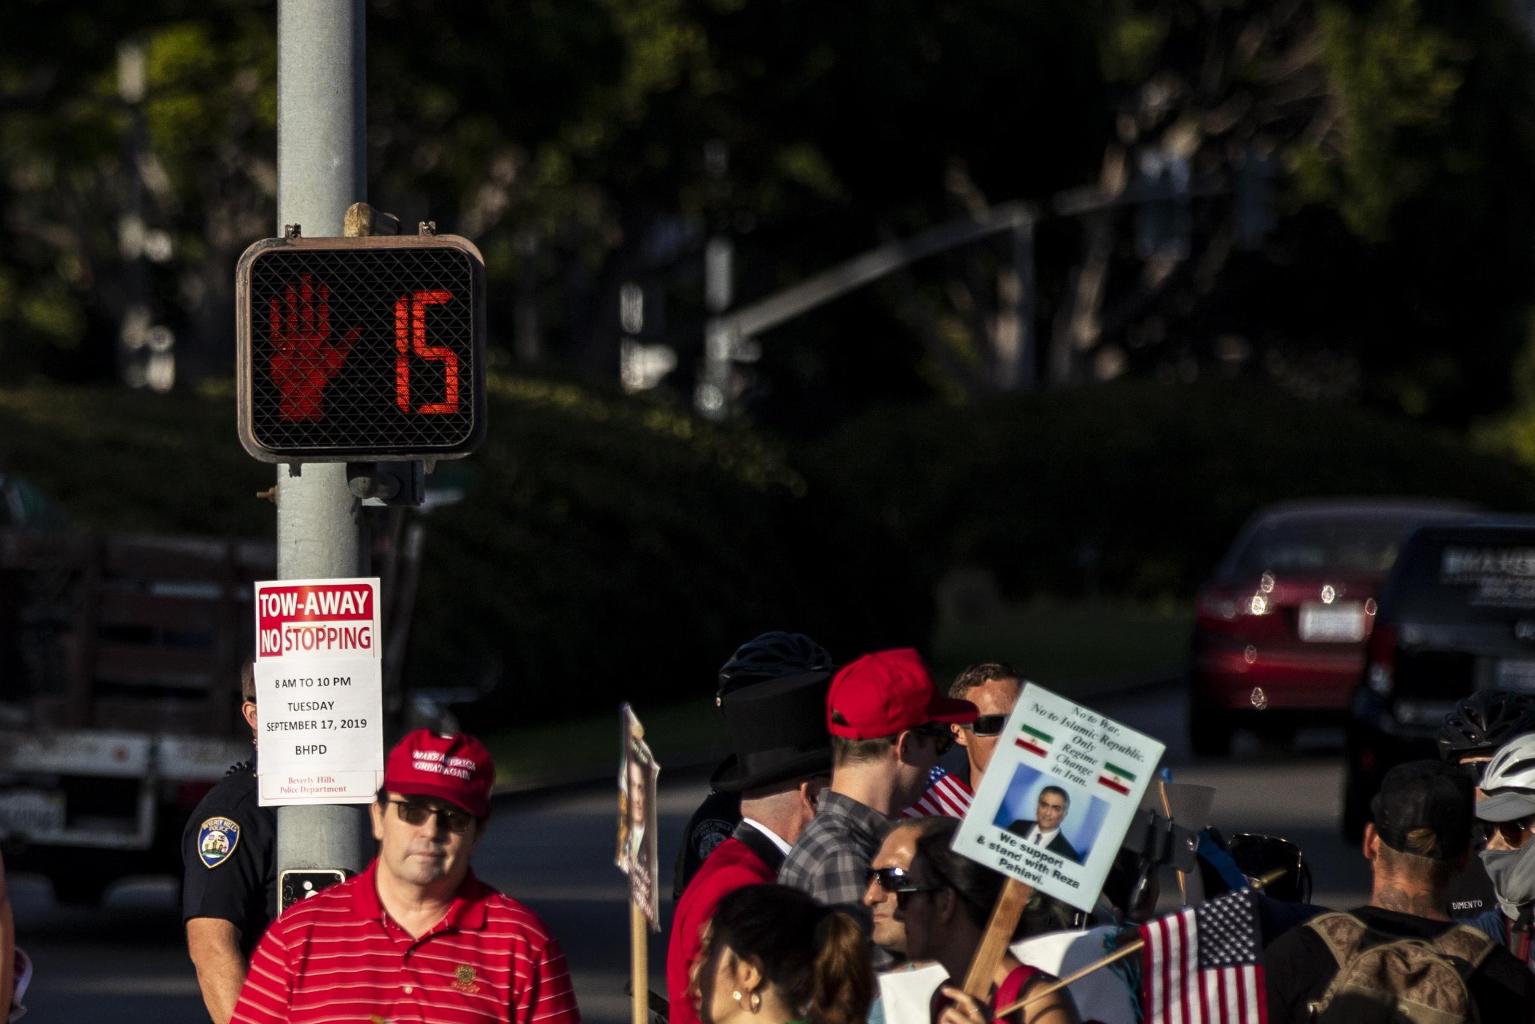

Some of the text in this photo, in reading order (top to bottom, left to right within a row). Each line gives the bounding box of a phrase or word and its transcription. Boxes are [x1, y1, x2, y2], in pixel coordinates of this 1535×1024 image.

[394, 289, 459, 415] 15
[260, 590, 369, 618] TOW-AWAY
[261, 626, 372, 653] NO STOPPING
[275, 677, 352, 688] 8 AM TO 10 PM
[287, 701, 335, 712] TUESDAY
[1072, 706, 1086, 719] No
[1087, 715, 1098, 725] to
[266, 719, 368, 732] SEPTEMBER 17, 2019
[1031, 703, 1047, 717] No
[1048, 712, 1059, 722] to
[1059, 715, 1098, 739] Islamic
[295, 744, 328, 755] BHPD
[1072, 734, 1098, 752] Only
[439, 753, 476, 771] AERICA
[1062, 743, 1099, 766] Regime
[1051, 765, 1061, 775] in
[1056, 754, 1094, 777] Change
[280, 785, 347, 794] Police Department
[288, 776, 336, 786] Beverly Hills
[999, 832, 1064, 868] We support
[988, 842, 1023, 861] stand
[1025, 858, 1050, 875] with
[1052, 870, 1081, 889] Reza
[998, 858, 1044, 885] Pahlavi.
